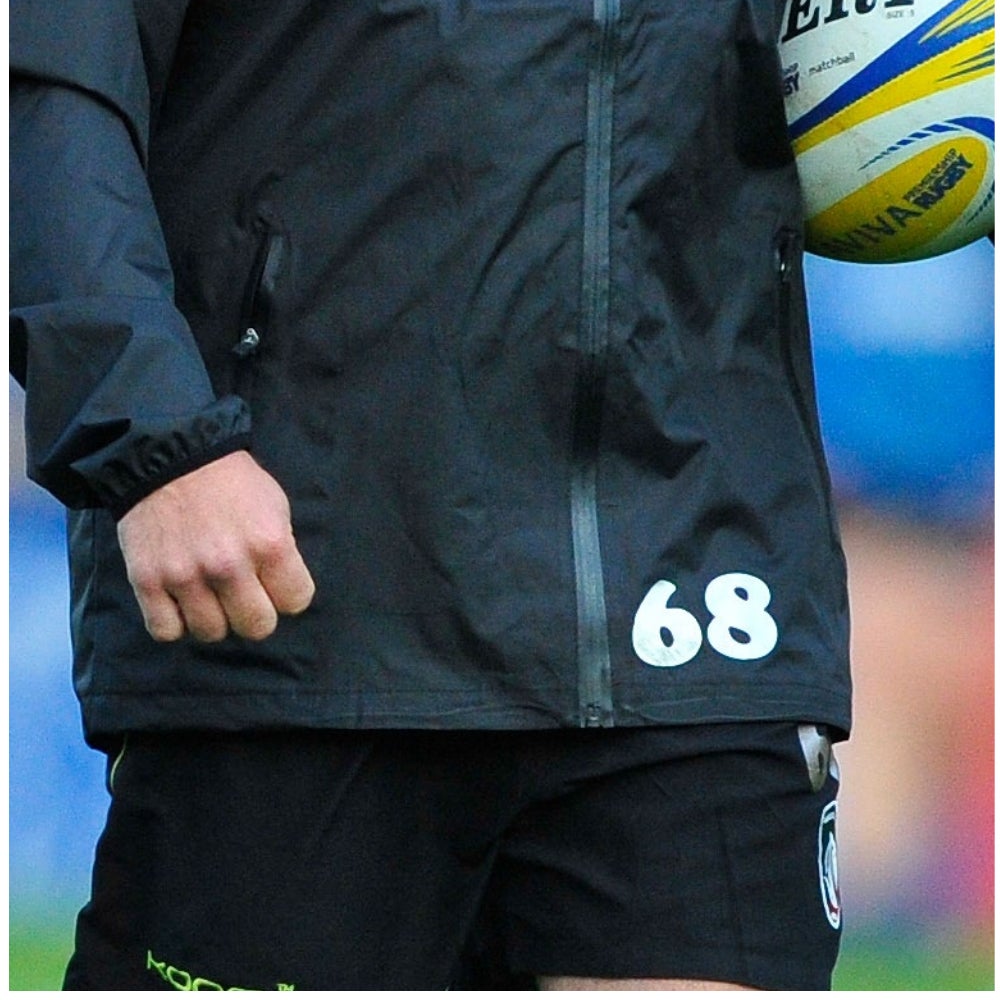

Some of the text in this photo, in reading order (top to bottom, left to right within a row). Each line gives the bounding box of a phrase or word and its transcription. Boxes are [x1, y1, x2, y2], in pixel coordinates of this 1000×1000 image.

[808, 51, 856, 76] matchball
[912, 152, 974, 210] RUGBY
[632, 572, 778, 667] 68
